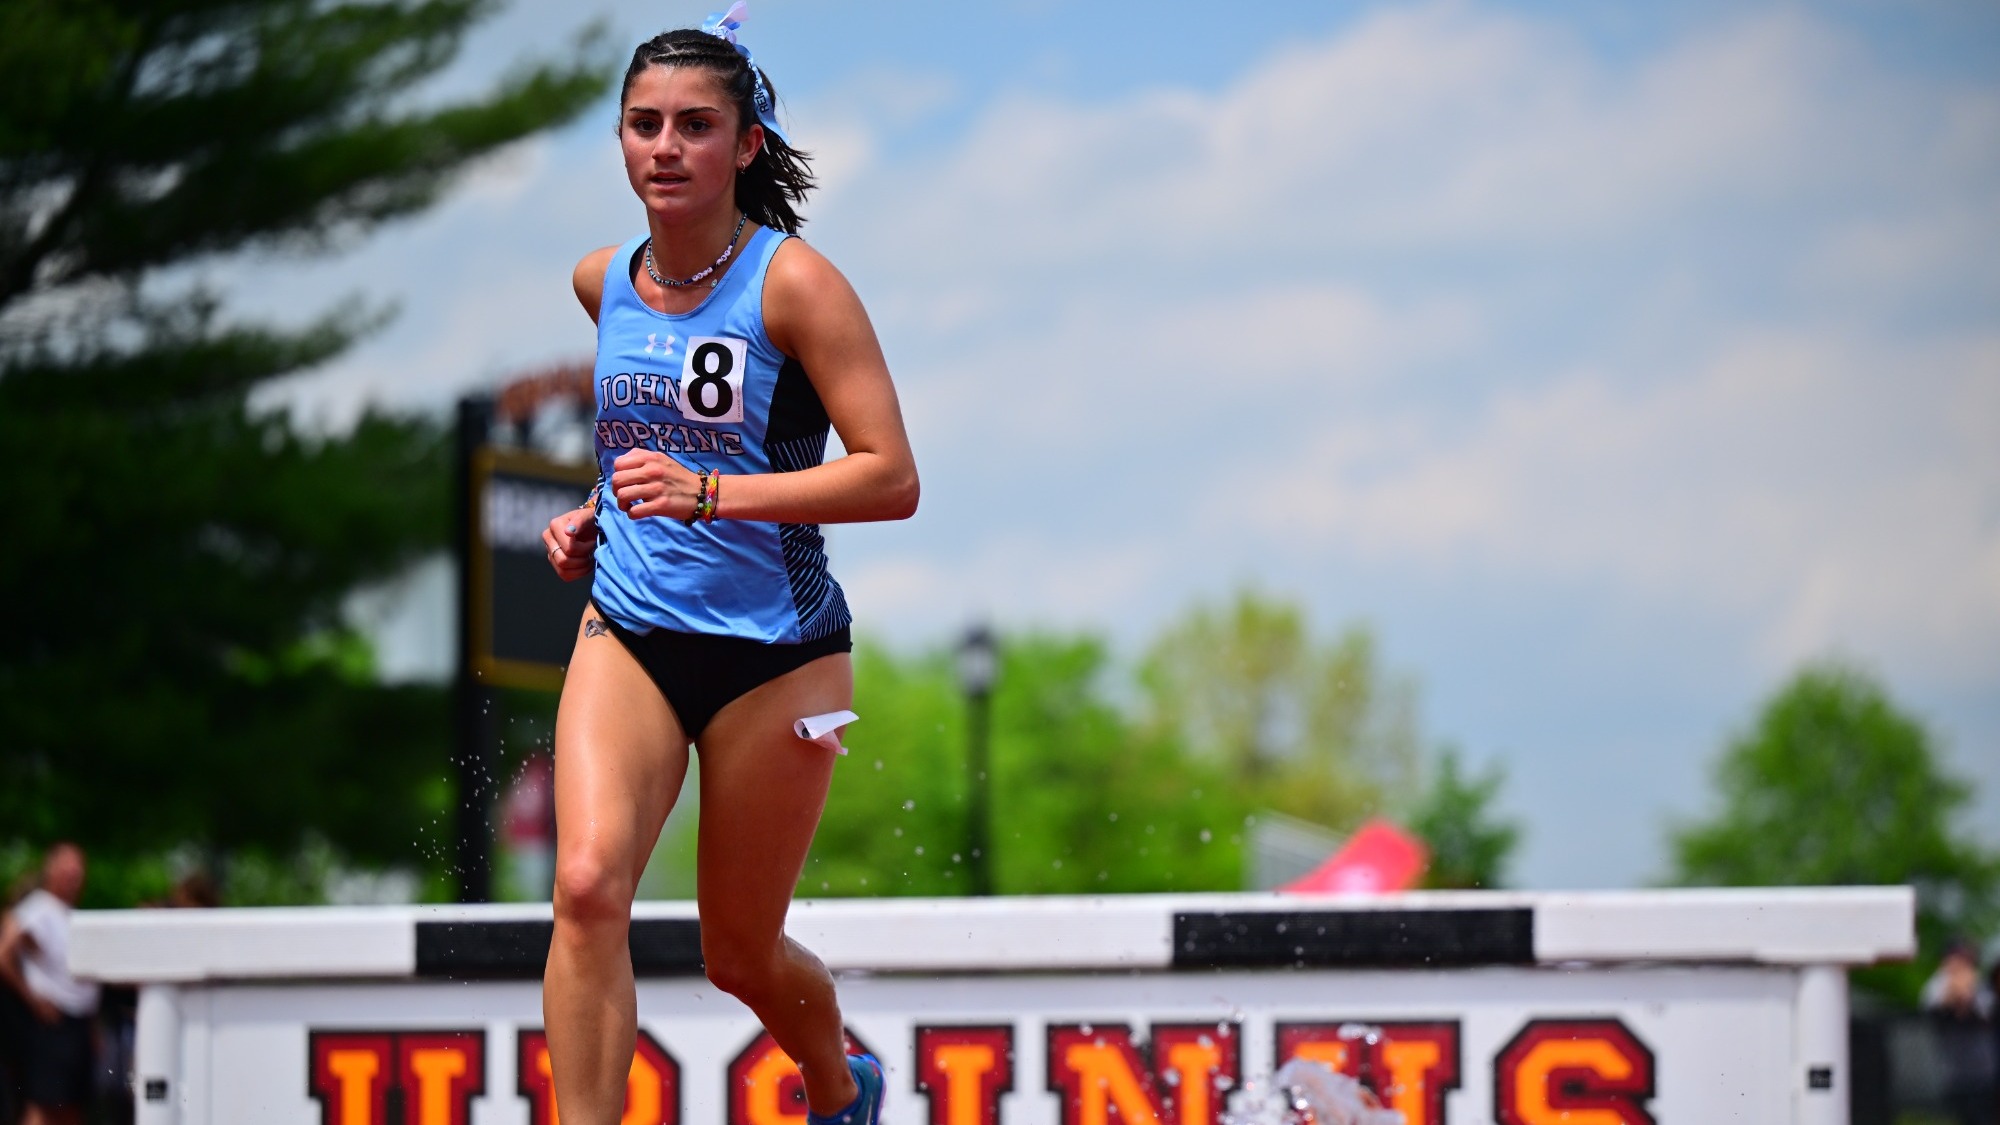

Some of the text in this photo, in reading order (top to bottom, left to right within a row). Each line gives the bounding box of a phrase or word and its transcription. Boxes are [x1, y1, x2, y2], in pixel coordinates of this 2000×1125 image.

[601, 373, 683, 414] JOHN
[687, 342, 733, 417] 8
[595, 420, 746, 456] HOPKINS
